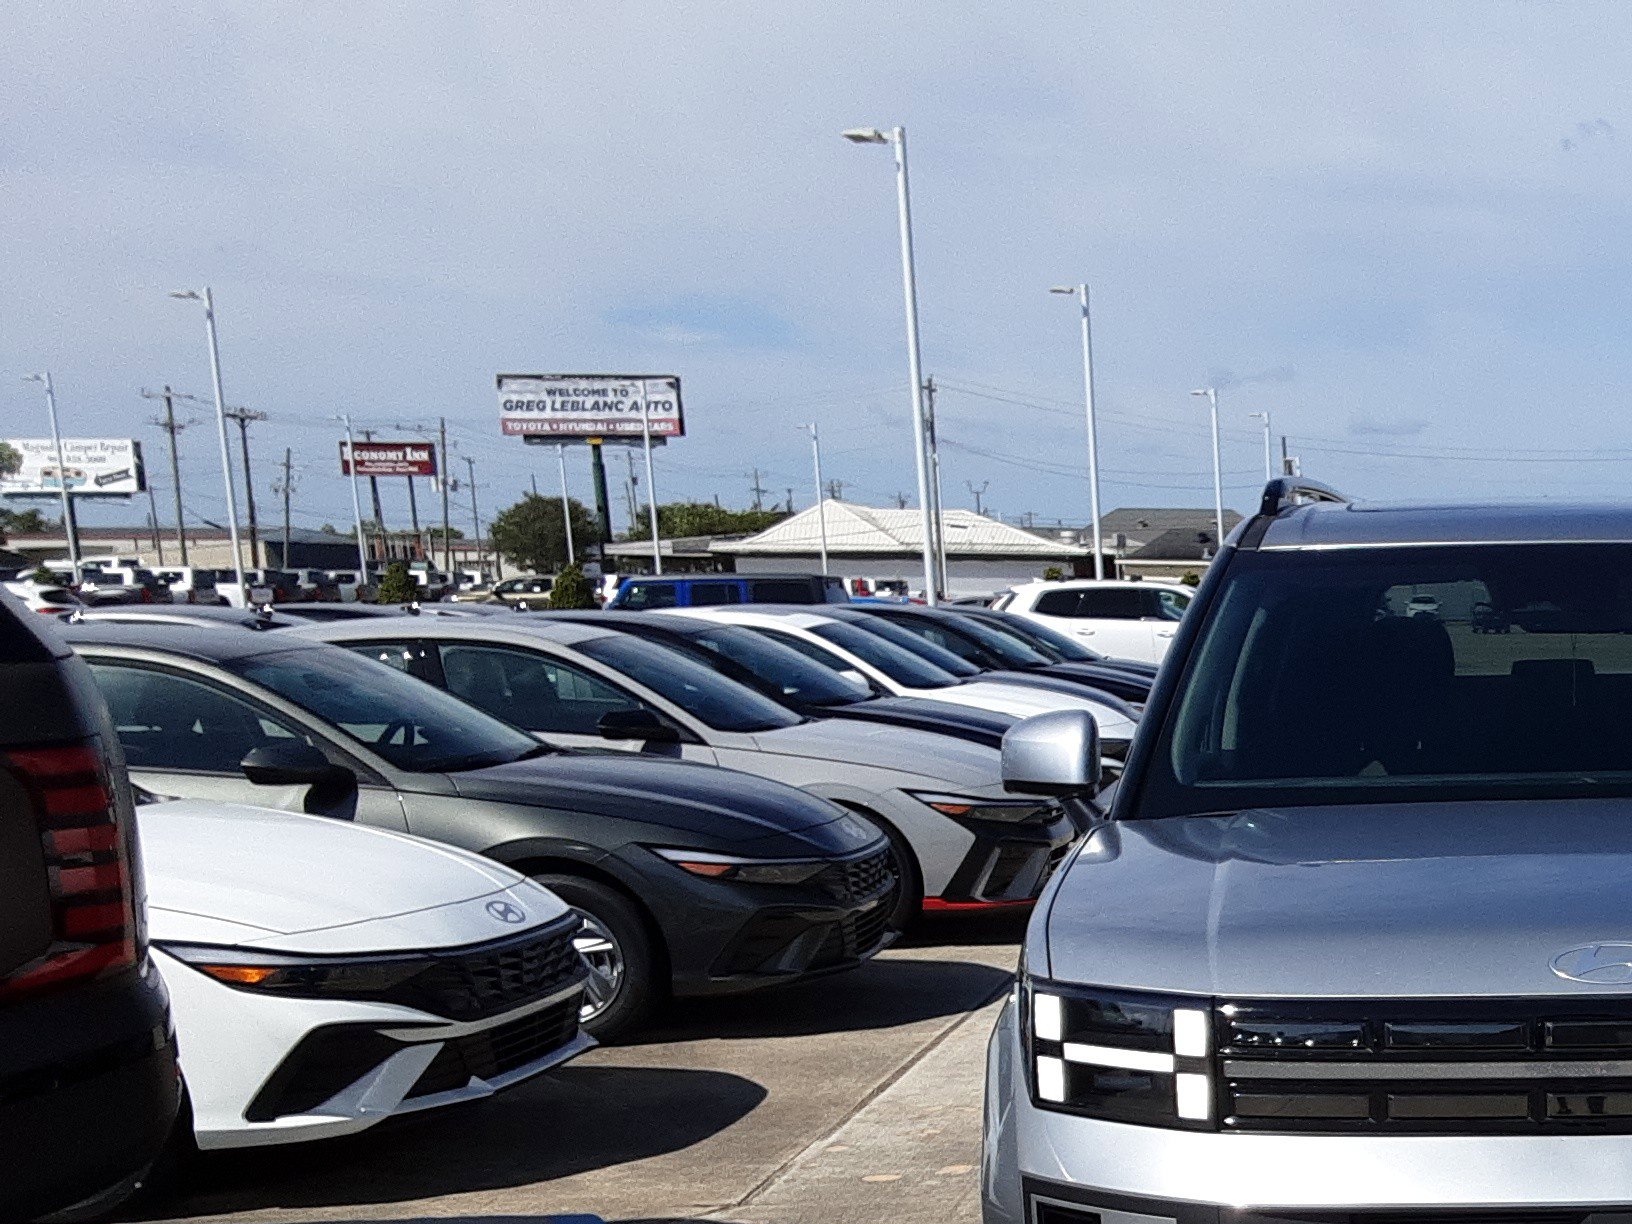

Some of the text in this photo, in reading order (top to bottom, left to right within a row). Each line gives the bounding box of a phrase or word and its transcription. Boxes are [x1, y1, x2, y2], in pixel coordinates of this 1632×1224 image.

[546, 388, 629, 397] WELCOME TO
[503, 400, 547, 412] GREG
[551, 400, 625, 412] LEBLANC
[505, 421, 551, 431] TOYOTA
[558, 422, 608, 431] HYUNDAI
